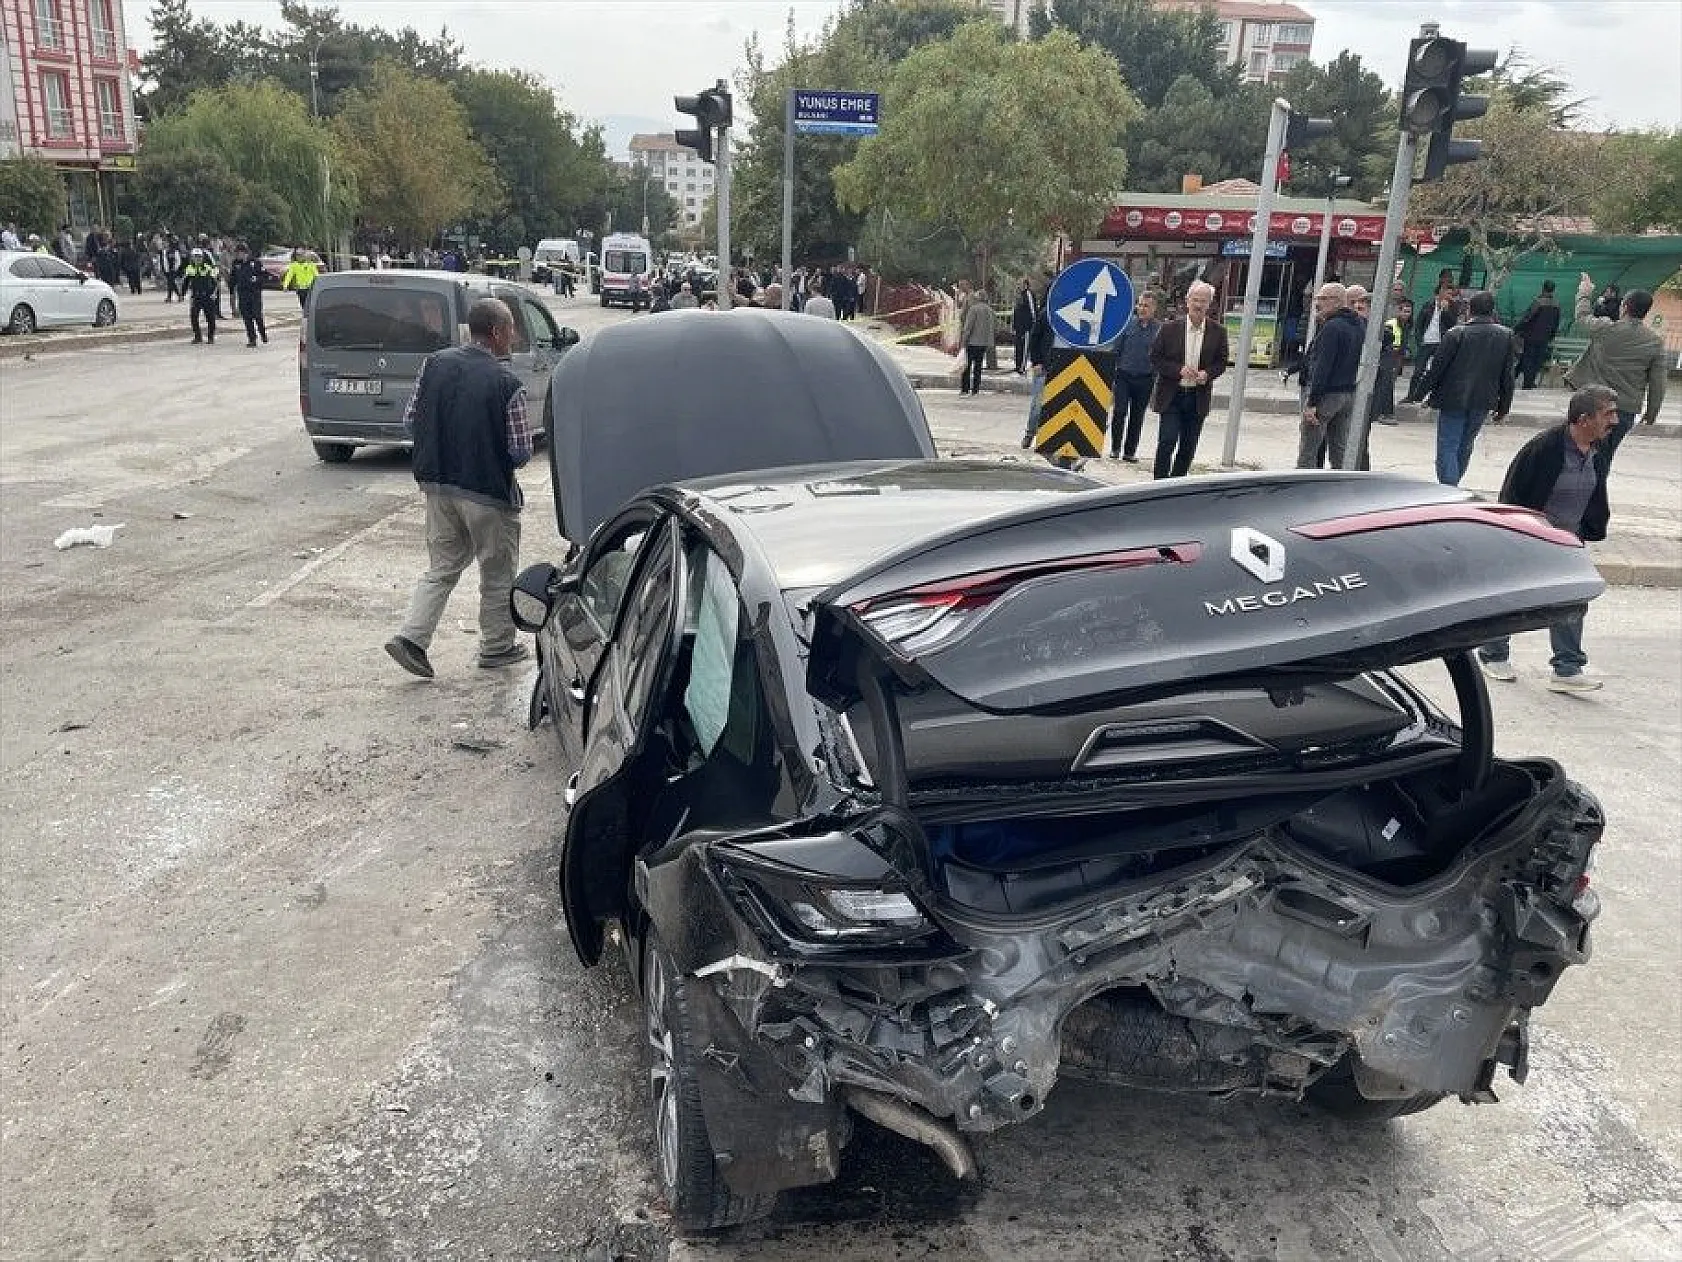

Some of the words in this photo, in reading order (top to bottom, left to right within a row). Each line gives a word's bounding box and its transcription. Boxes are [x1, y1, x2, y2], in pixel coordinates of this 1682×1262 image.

[798, 96, 838, 110] YUNUS
[840, 98, 872, 111] EMRE
[1204, 572, 1368, 616] MEGANE
